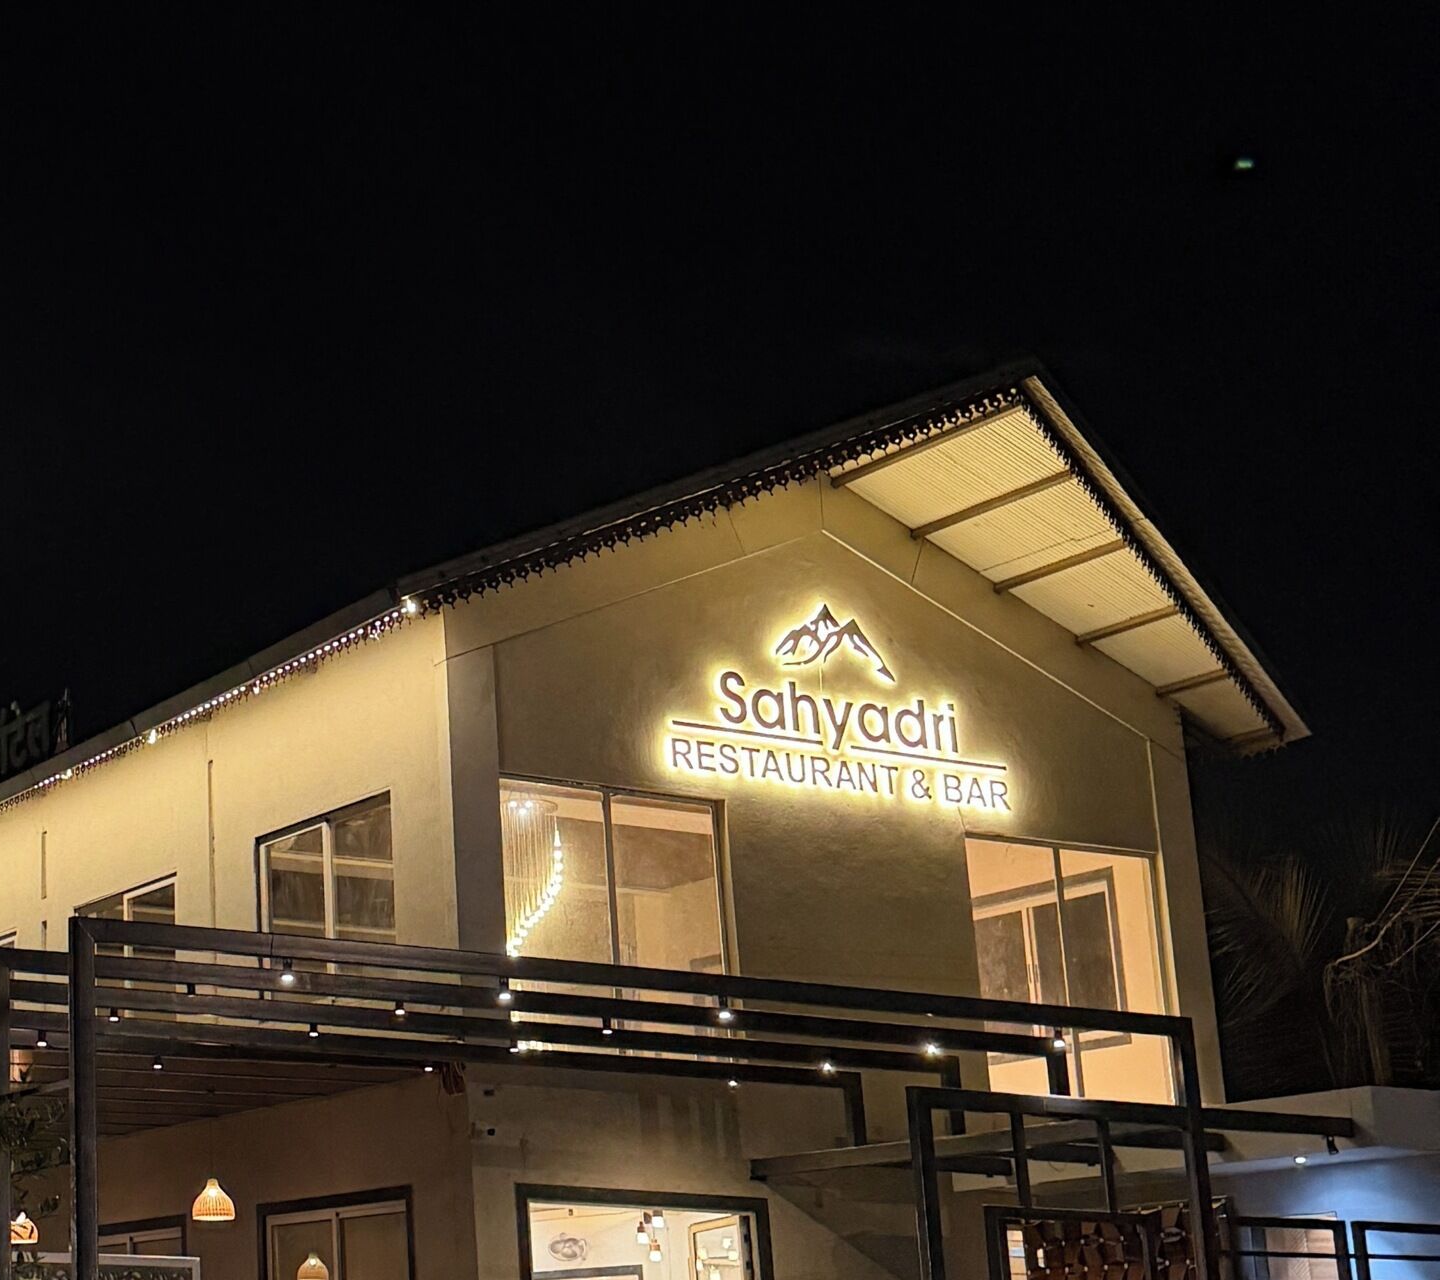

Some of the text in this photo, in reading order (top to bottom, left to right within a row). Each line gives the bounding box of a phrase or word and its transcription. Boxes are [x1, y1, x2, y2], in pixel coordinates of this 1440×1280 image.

[719, 670, 959, 753] Sahyadri
[670, 737, 1012, 811] RESTAURANT & BAR
